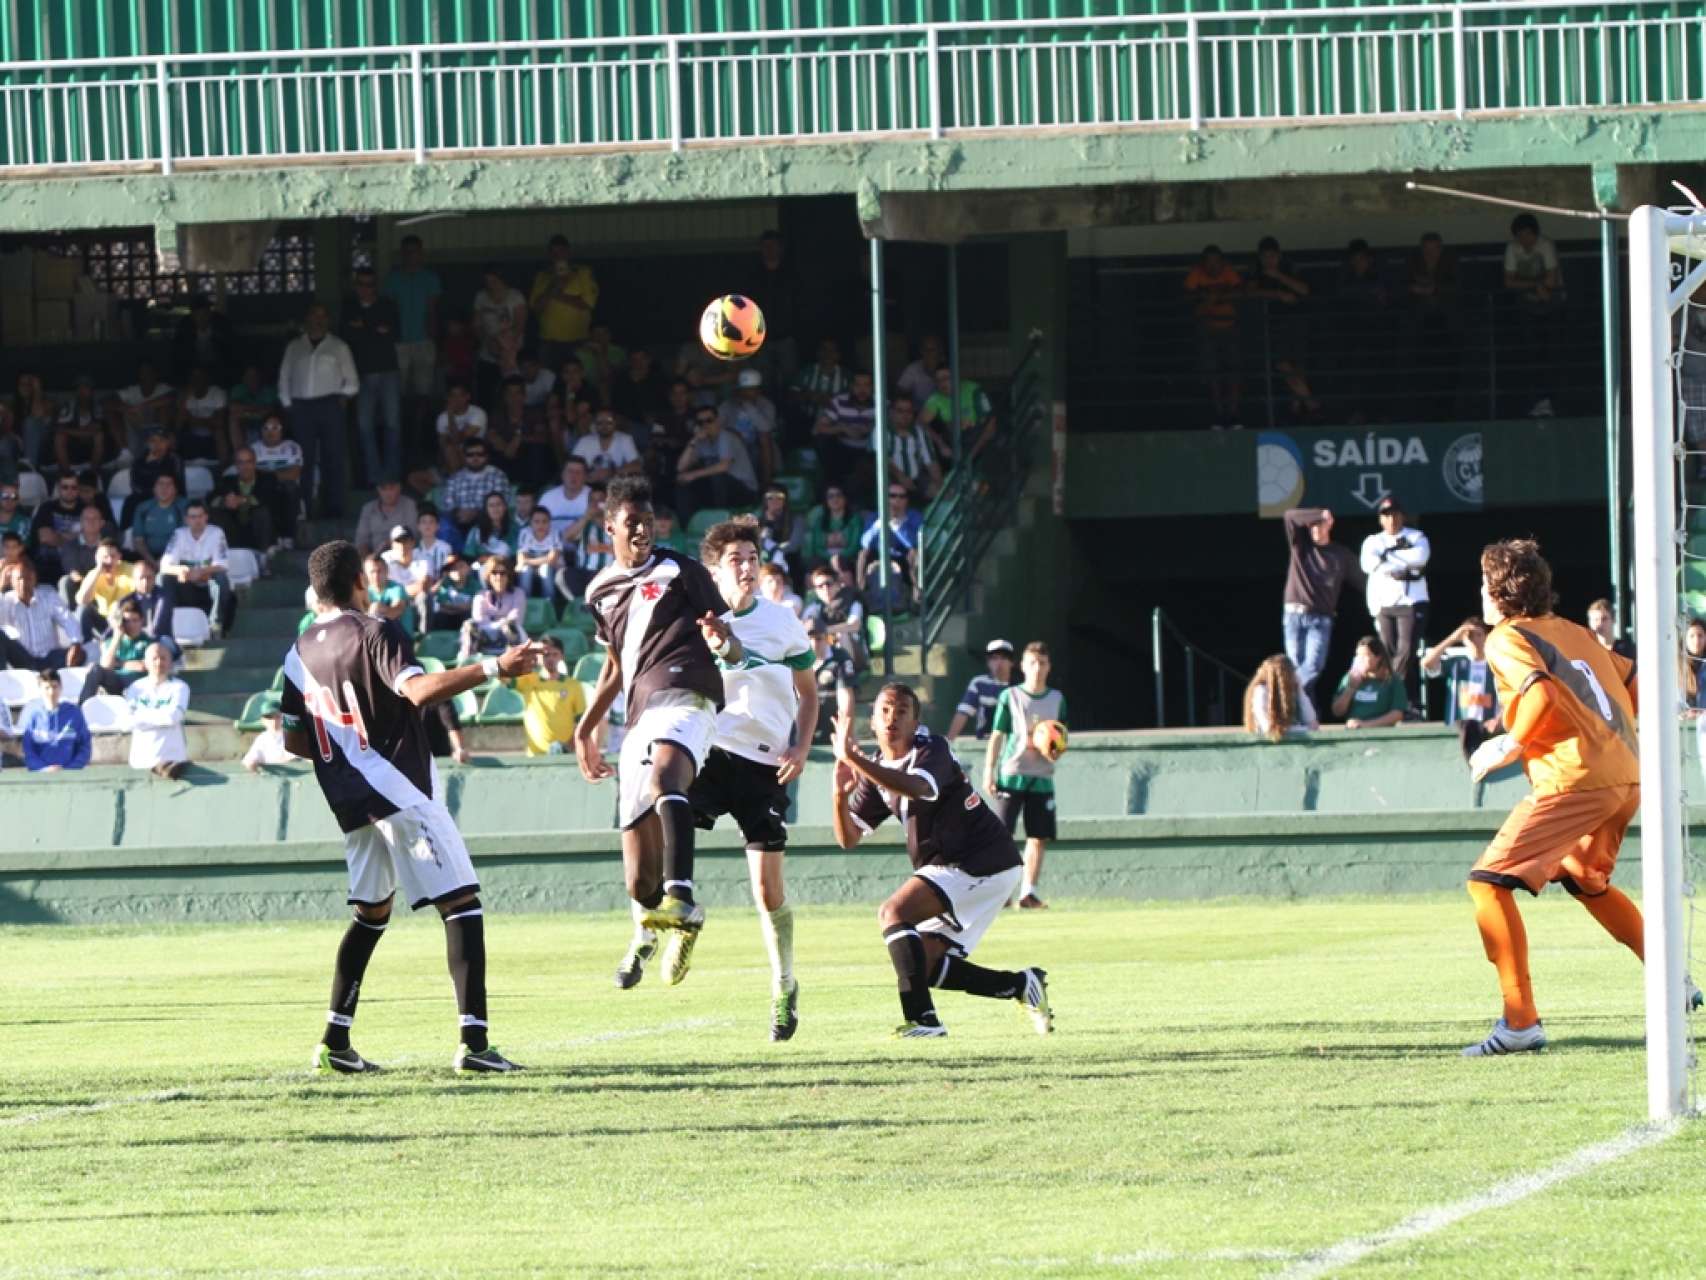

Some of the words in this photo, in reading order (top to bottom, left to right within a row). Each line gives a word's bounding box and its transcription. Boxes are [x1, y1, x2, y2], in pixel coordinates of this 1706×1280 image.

[1313, 432, 1429, 467] SAÍDA
[304, 679, 369, 763] 14
[1570, 659, 1612, 721] 1
